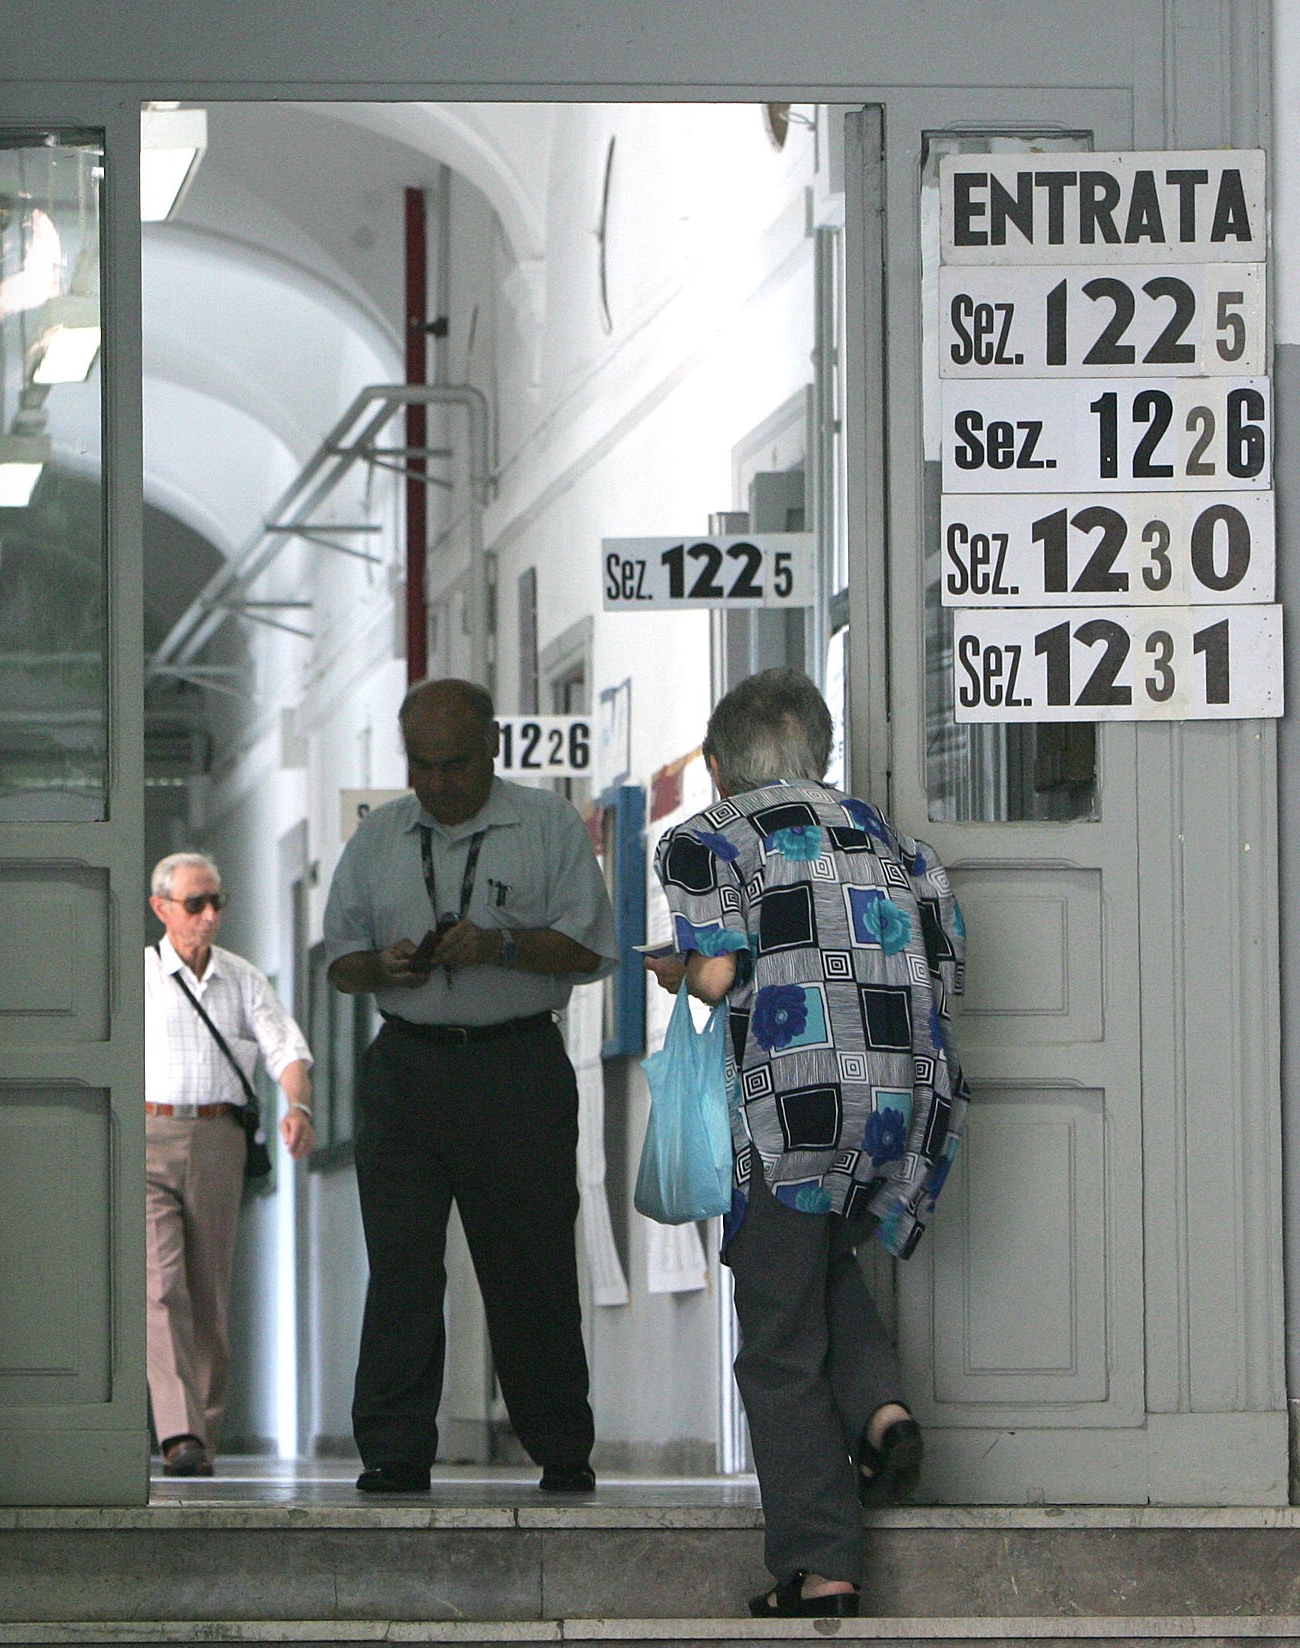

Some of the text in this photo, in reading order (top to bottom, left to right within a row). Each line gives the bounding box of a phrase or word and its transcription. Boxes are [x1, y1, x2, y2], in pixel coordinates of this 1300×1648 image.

[953, 168, 1253, 247] ENTRATA
[950, 276, 1246, 367] Sez. 1225
[954, 387, 1266, 481] Sez. 1226
[606, 541, 794, 601] Sez. 1225
[946, 503, 1252, 596] Sez. 1230
[958, 618, 1231, 708] Sez. 1231
[500, 722, 590, 769] 1226
